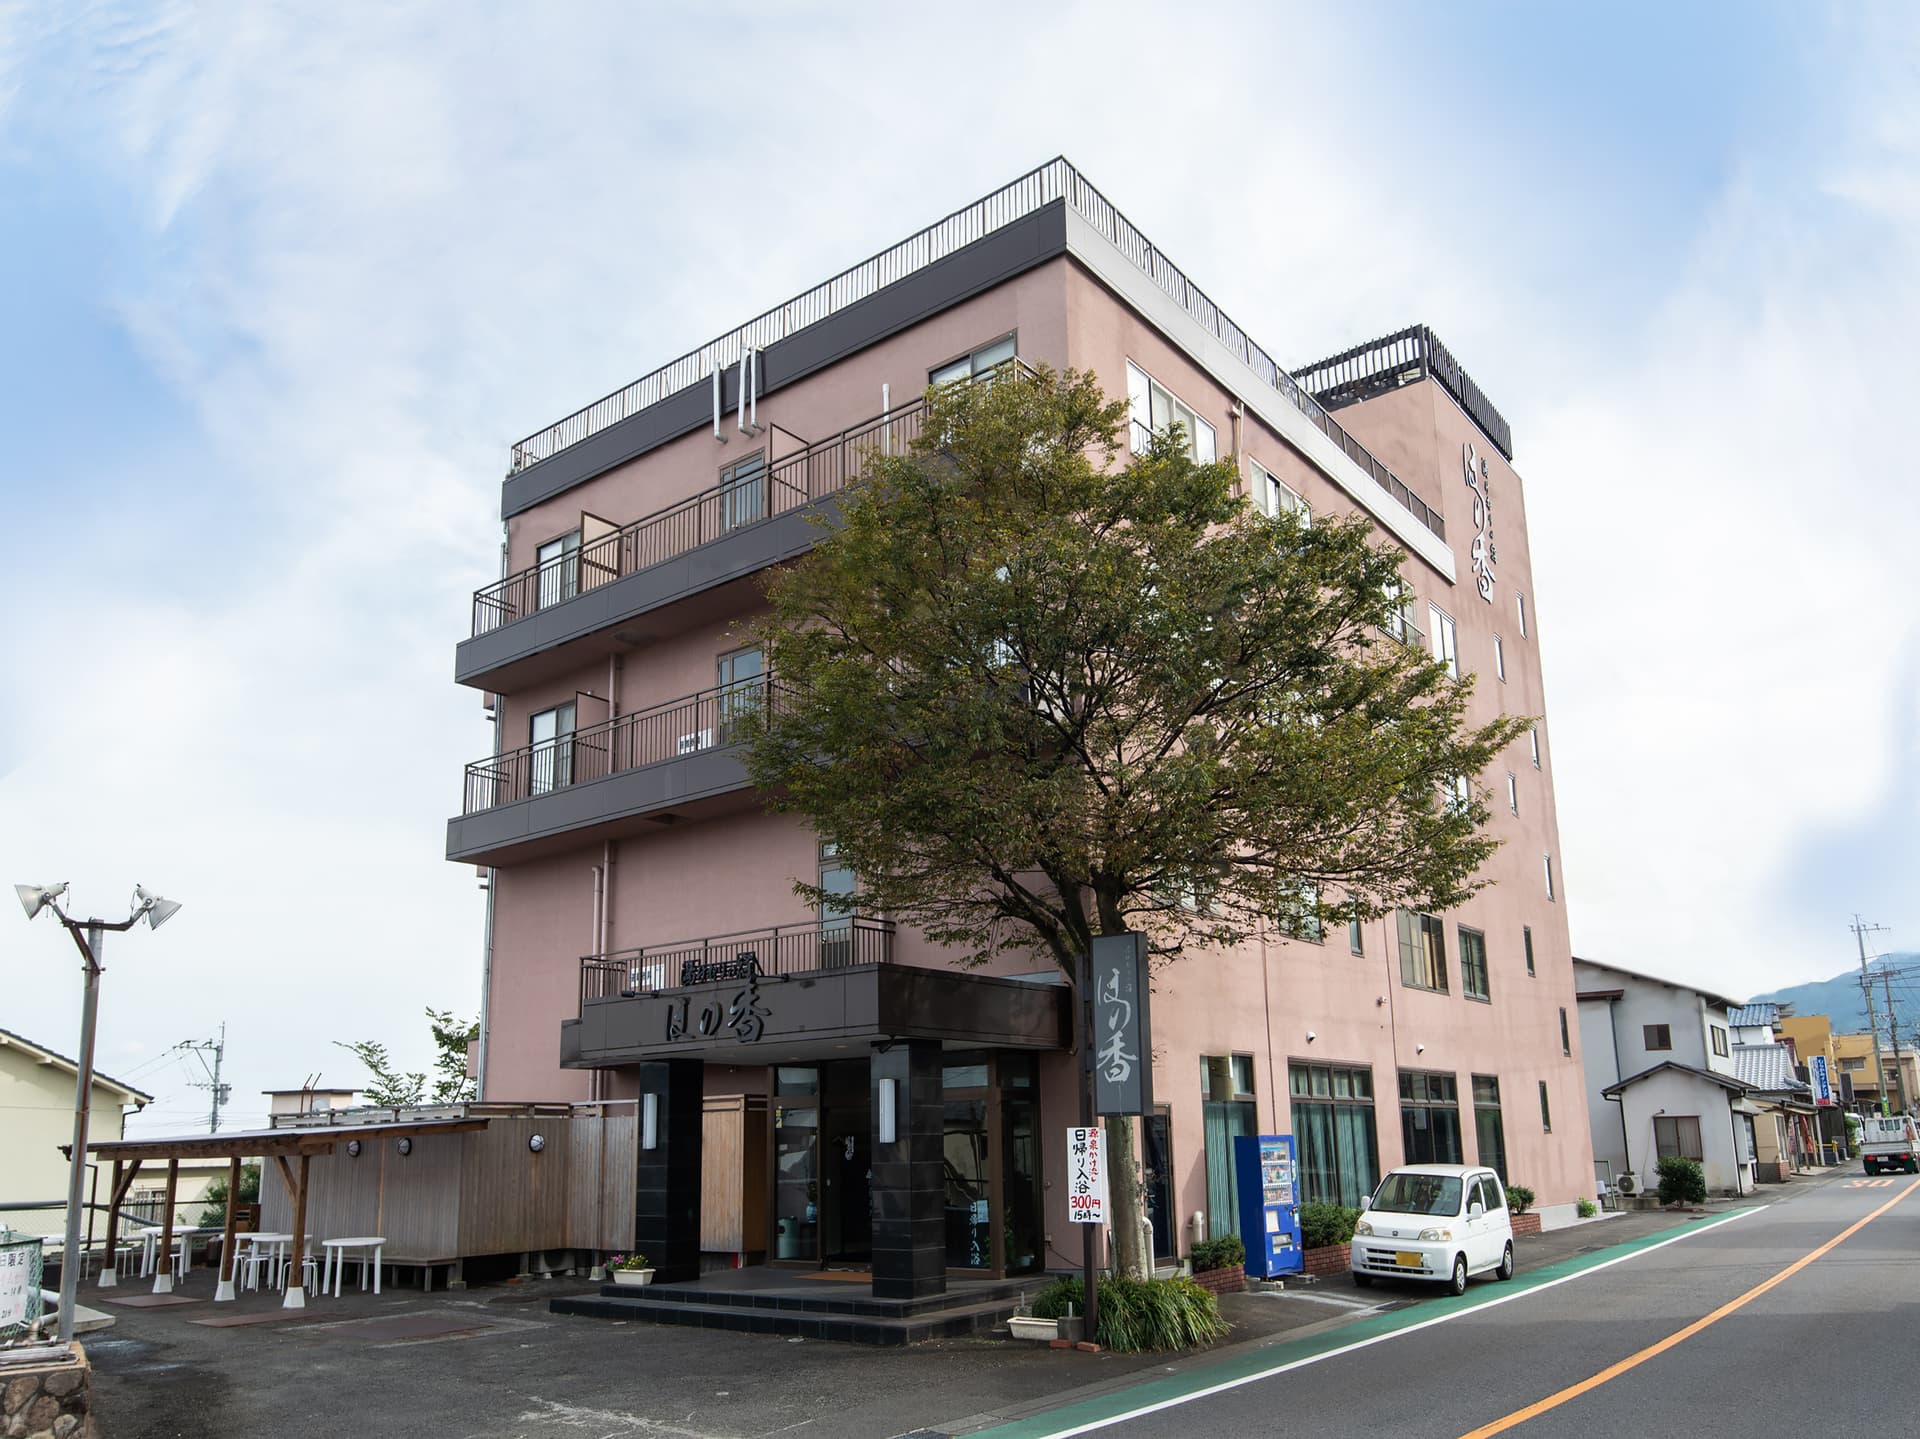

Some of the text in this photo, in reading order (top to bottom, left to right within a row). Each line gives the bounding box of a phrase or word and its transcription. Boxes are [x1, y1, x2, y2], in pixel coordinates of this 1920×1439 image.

[1072, 1129, 1090, 1194] 日帰り入浴
[1088, 1128, 1099, 1182] 源泉かけ流し
[1070, 1194, 1101, 1209] 300円
